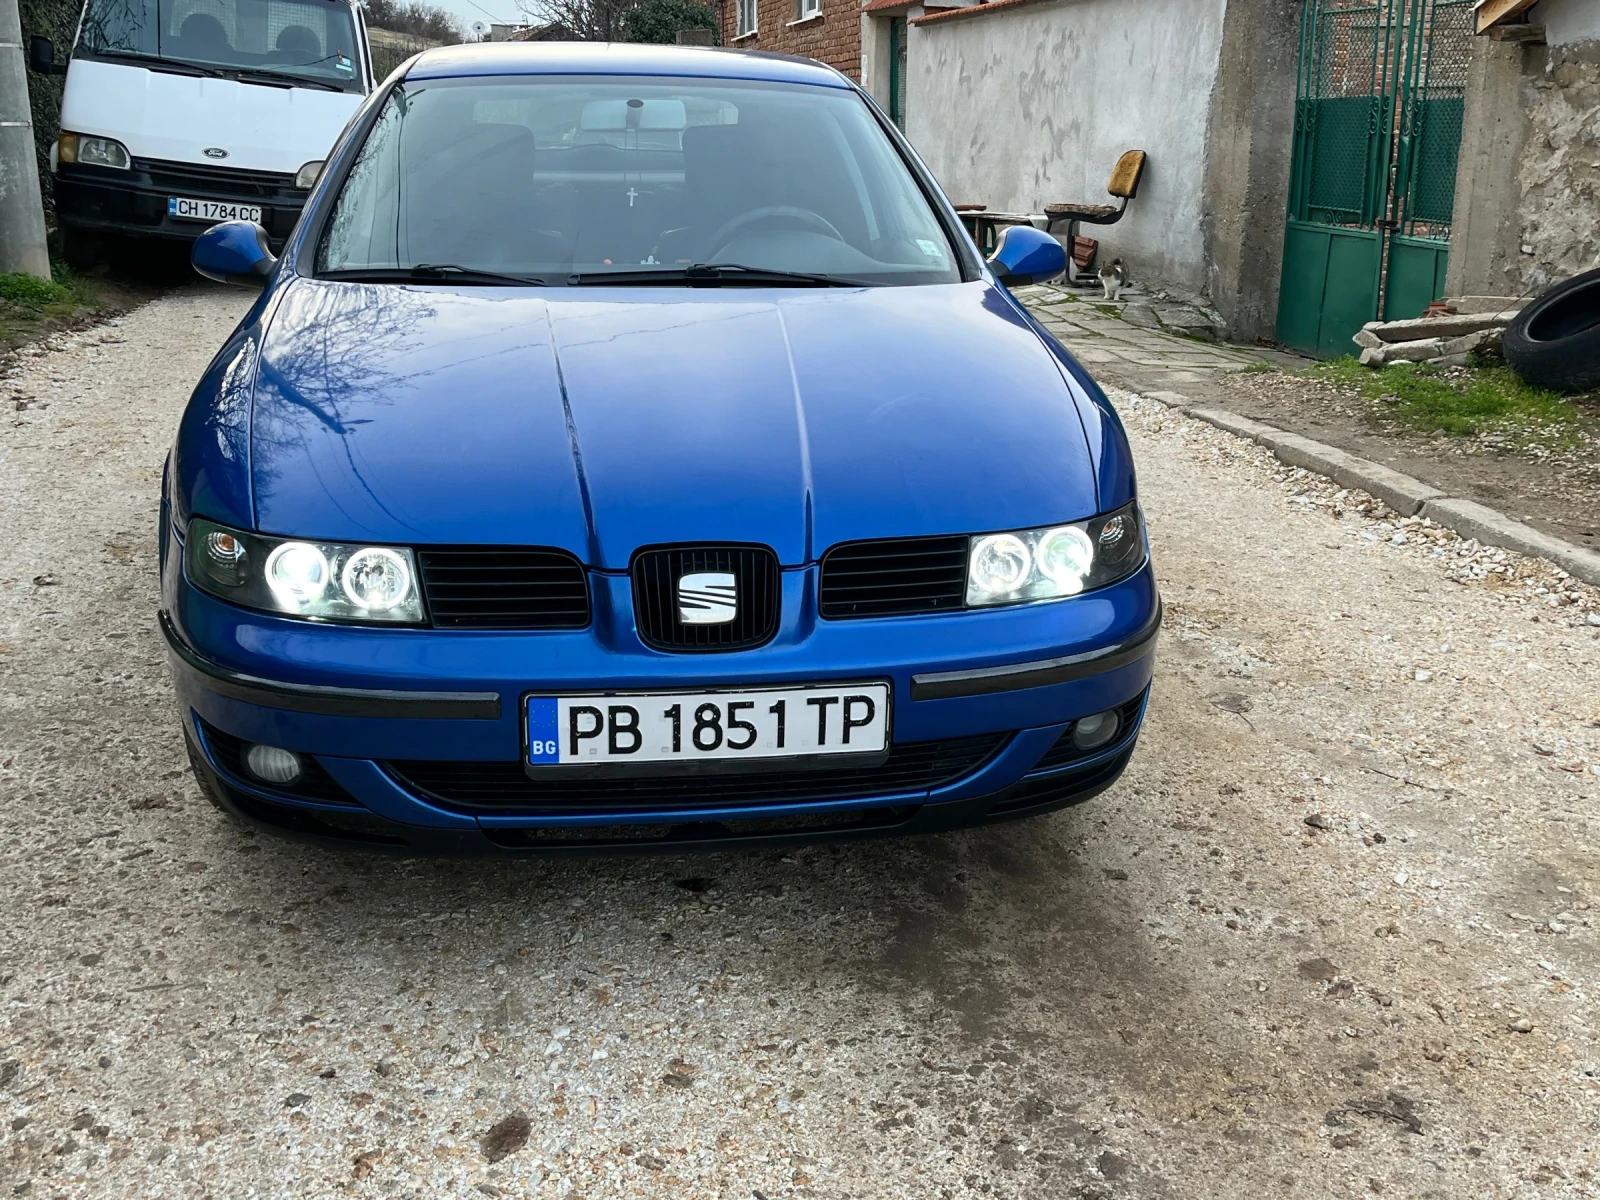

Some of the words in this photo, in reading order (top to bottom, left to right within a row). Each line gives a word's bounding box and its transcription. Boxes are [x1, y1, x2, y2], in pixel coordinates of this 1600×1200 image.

[179, 200, 198, 216] CH
[203, 203, 237, 220] 1784
[239, 207, 259, 222] CC
[568, 704, 643, 756] PB
[663, 699, 787, 753] 1851
[806, 694, 876, 746] TP
[532, 740, 557, 755] BG
